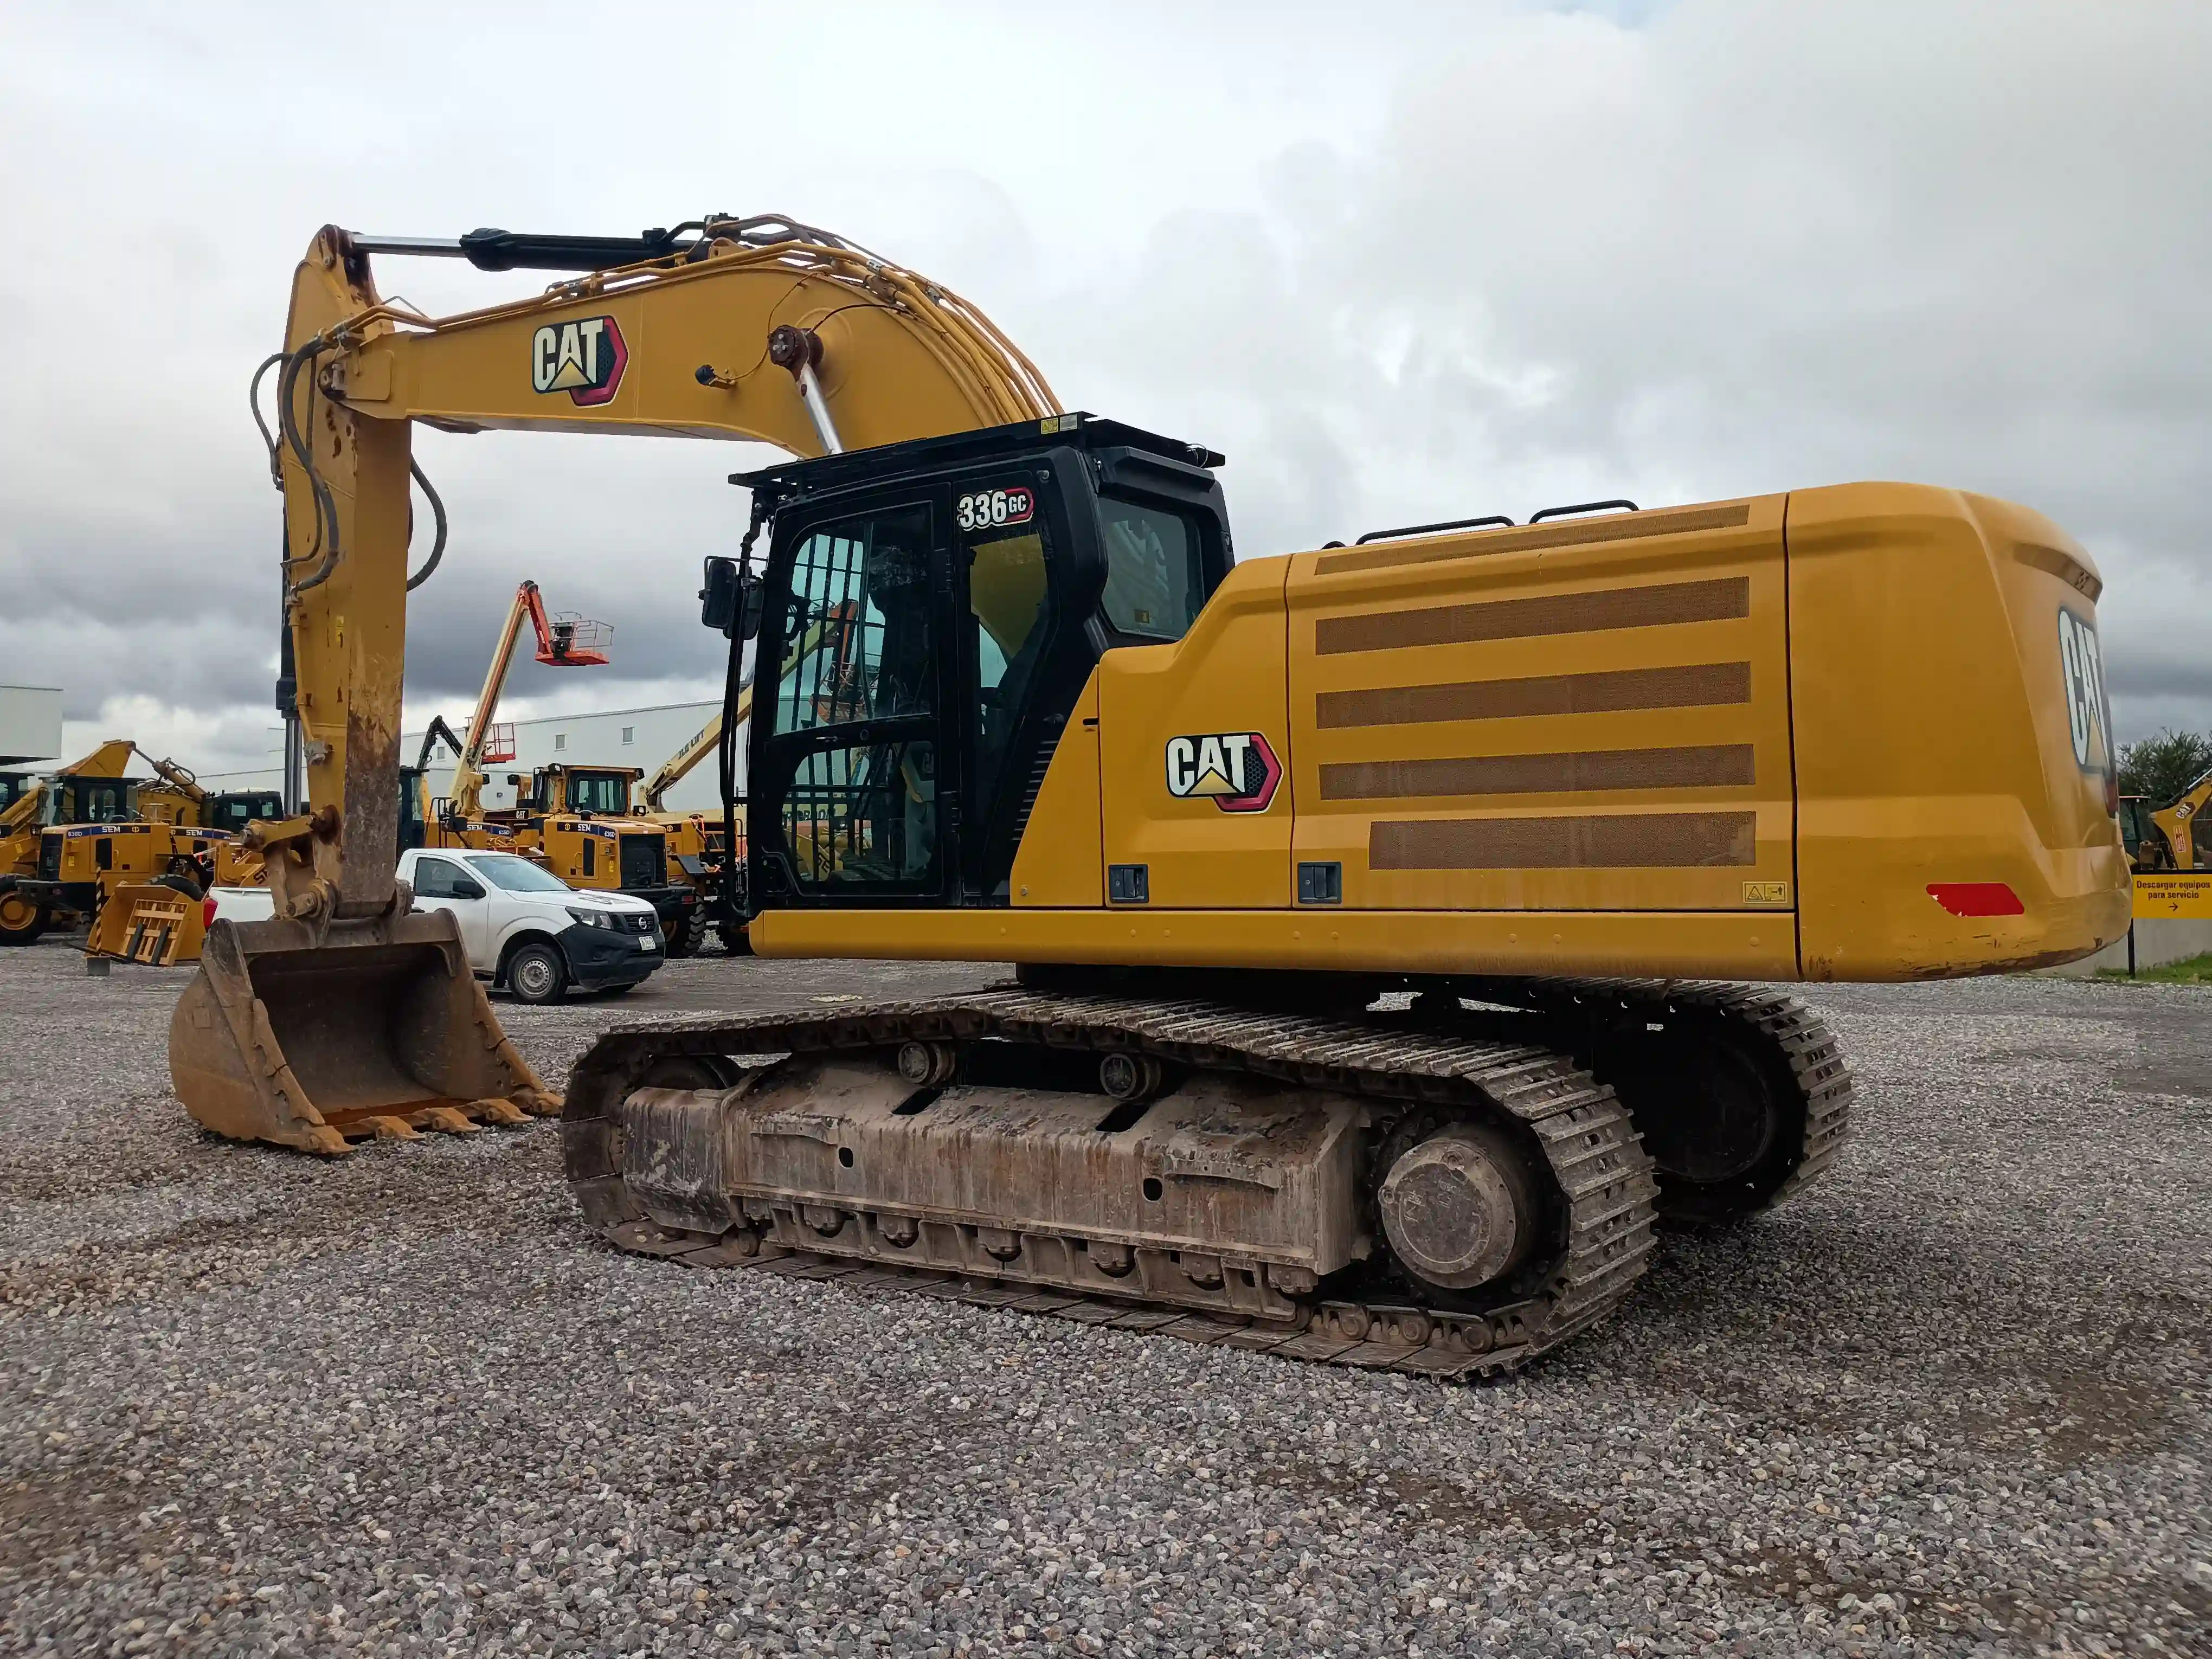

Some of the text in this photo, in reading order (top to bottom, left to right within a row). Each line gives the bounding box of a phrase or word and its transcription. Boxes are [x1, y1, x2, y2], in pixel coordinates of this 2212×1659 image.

[534, 319, 603, 391] CAT
[959, 491, 1026, 528] 336 GC
[2059, 610, 2111, 769] CAT
[678, 743, 689, 760] JLG
[1167, 735, 1250, 796] CAT
[516, 811, 525, 819] CAT
[2176, 803, 2192, 819] CAT
[577, 824, 591, 832] SEM
[2136, 880, 2210, 890] Descargar equipos
